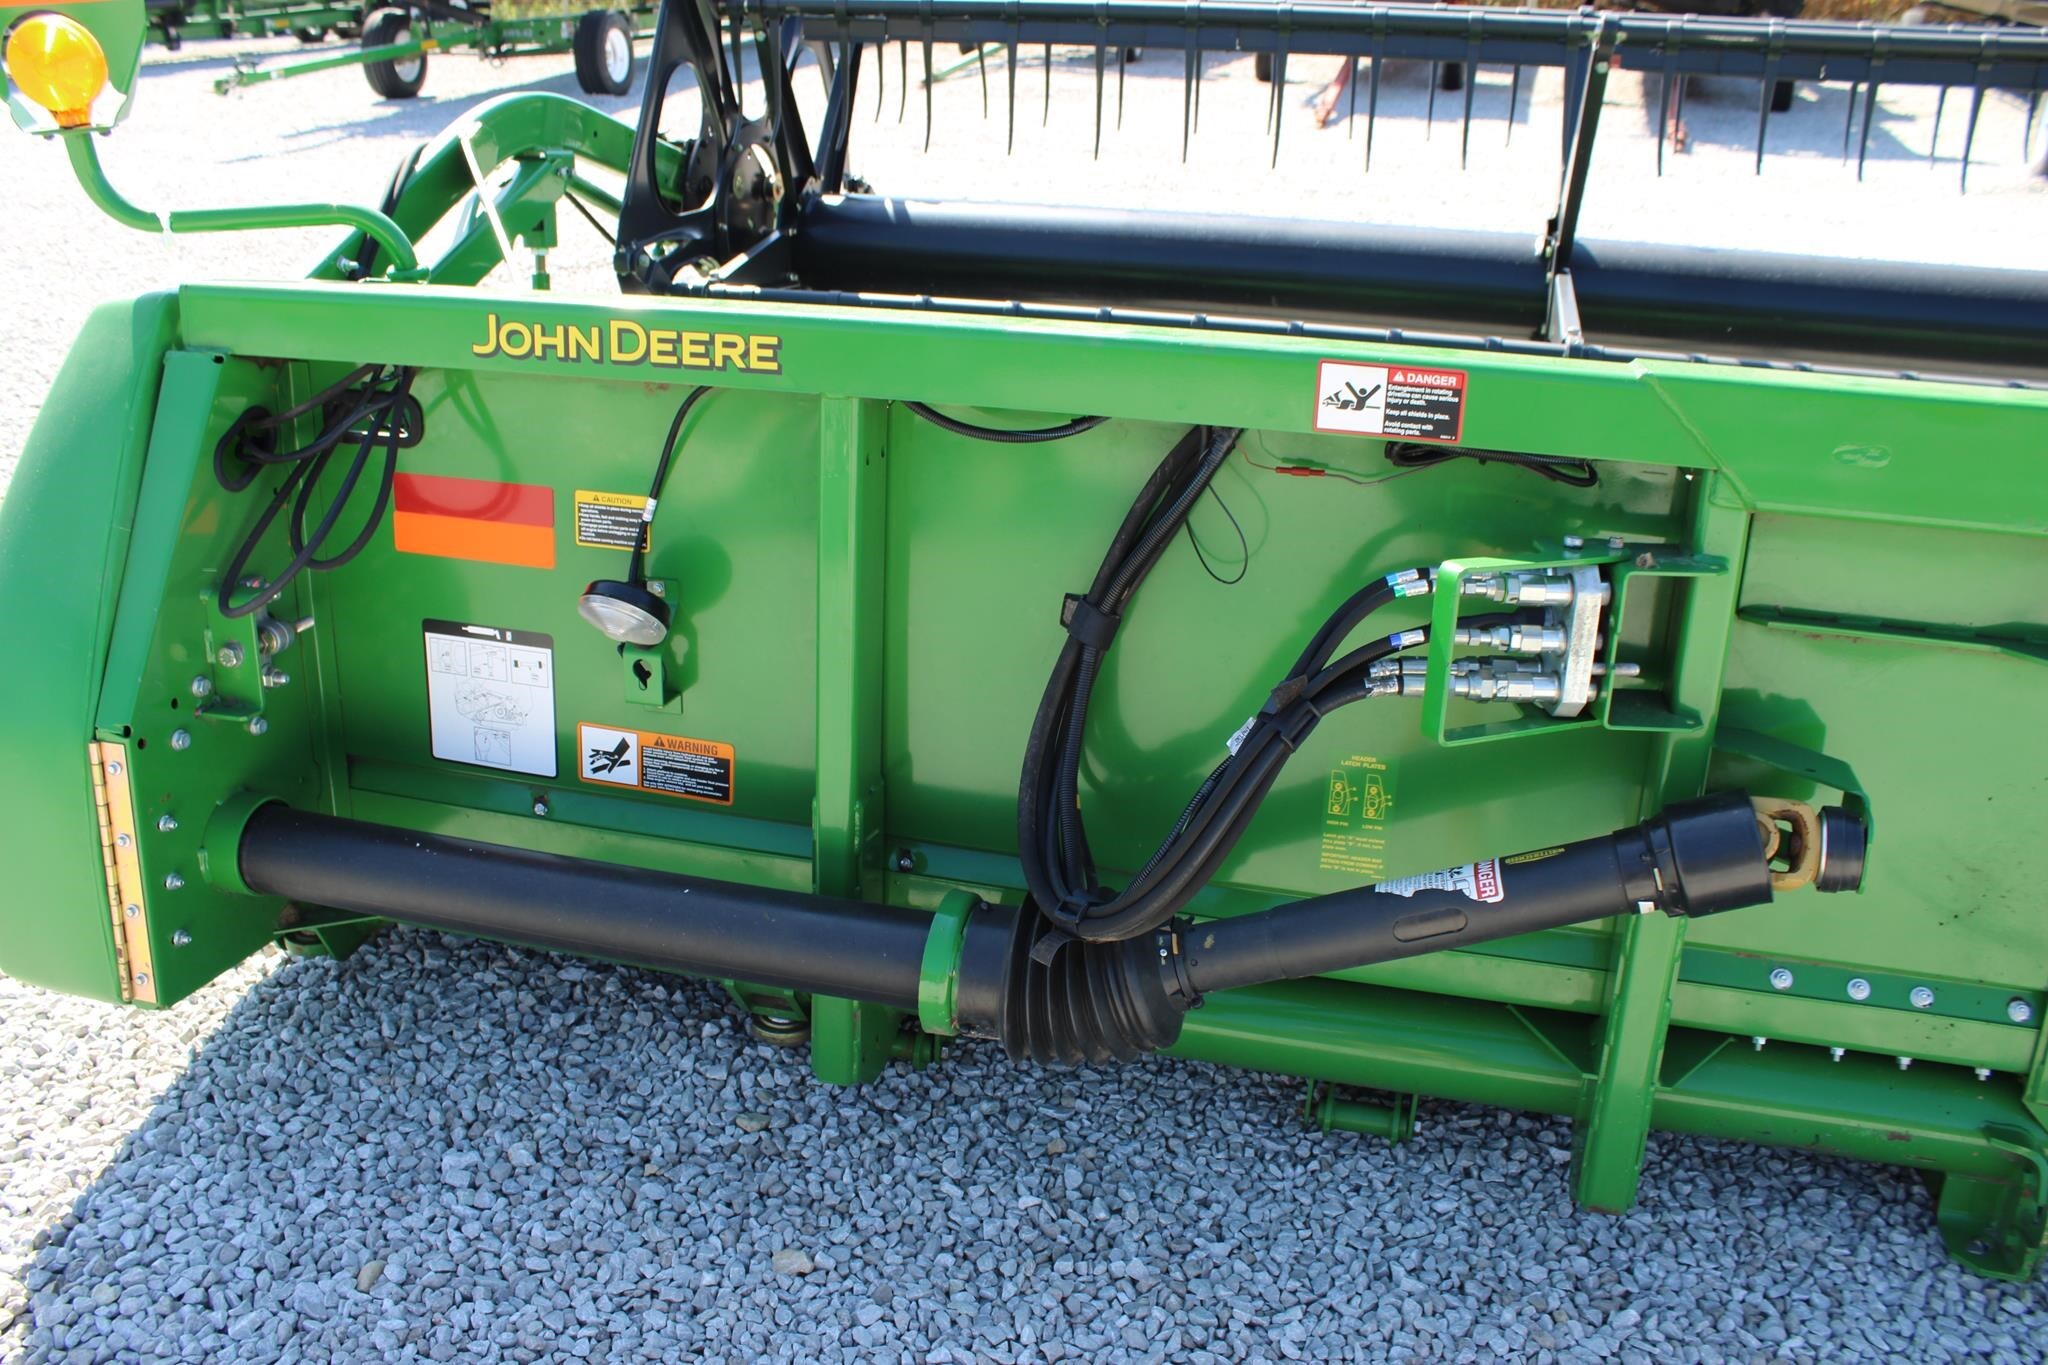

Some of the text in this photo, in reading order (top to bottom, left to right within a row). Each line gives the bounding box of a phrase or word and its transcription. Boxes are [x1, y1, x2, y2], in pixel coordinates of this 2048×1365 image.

[472, 313, 781, 374] JOHN DEERE
[1407, 373, 1456, 386] DANGER
[601, 496, 632, 505] CAUTION
[667, 738, 718, 756] WARNING
[1478, 860, 1496, 897] NGER
